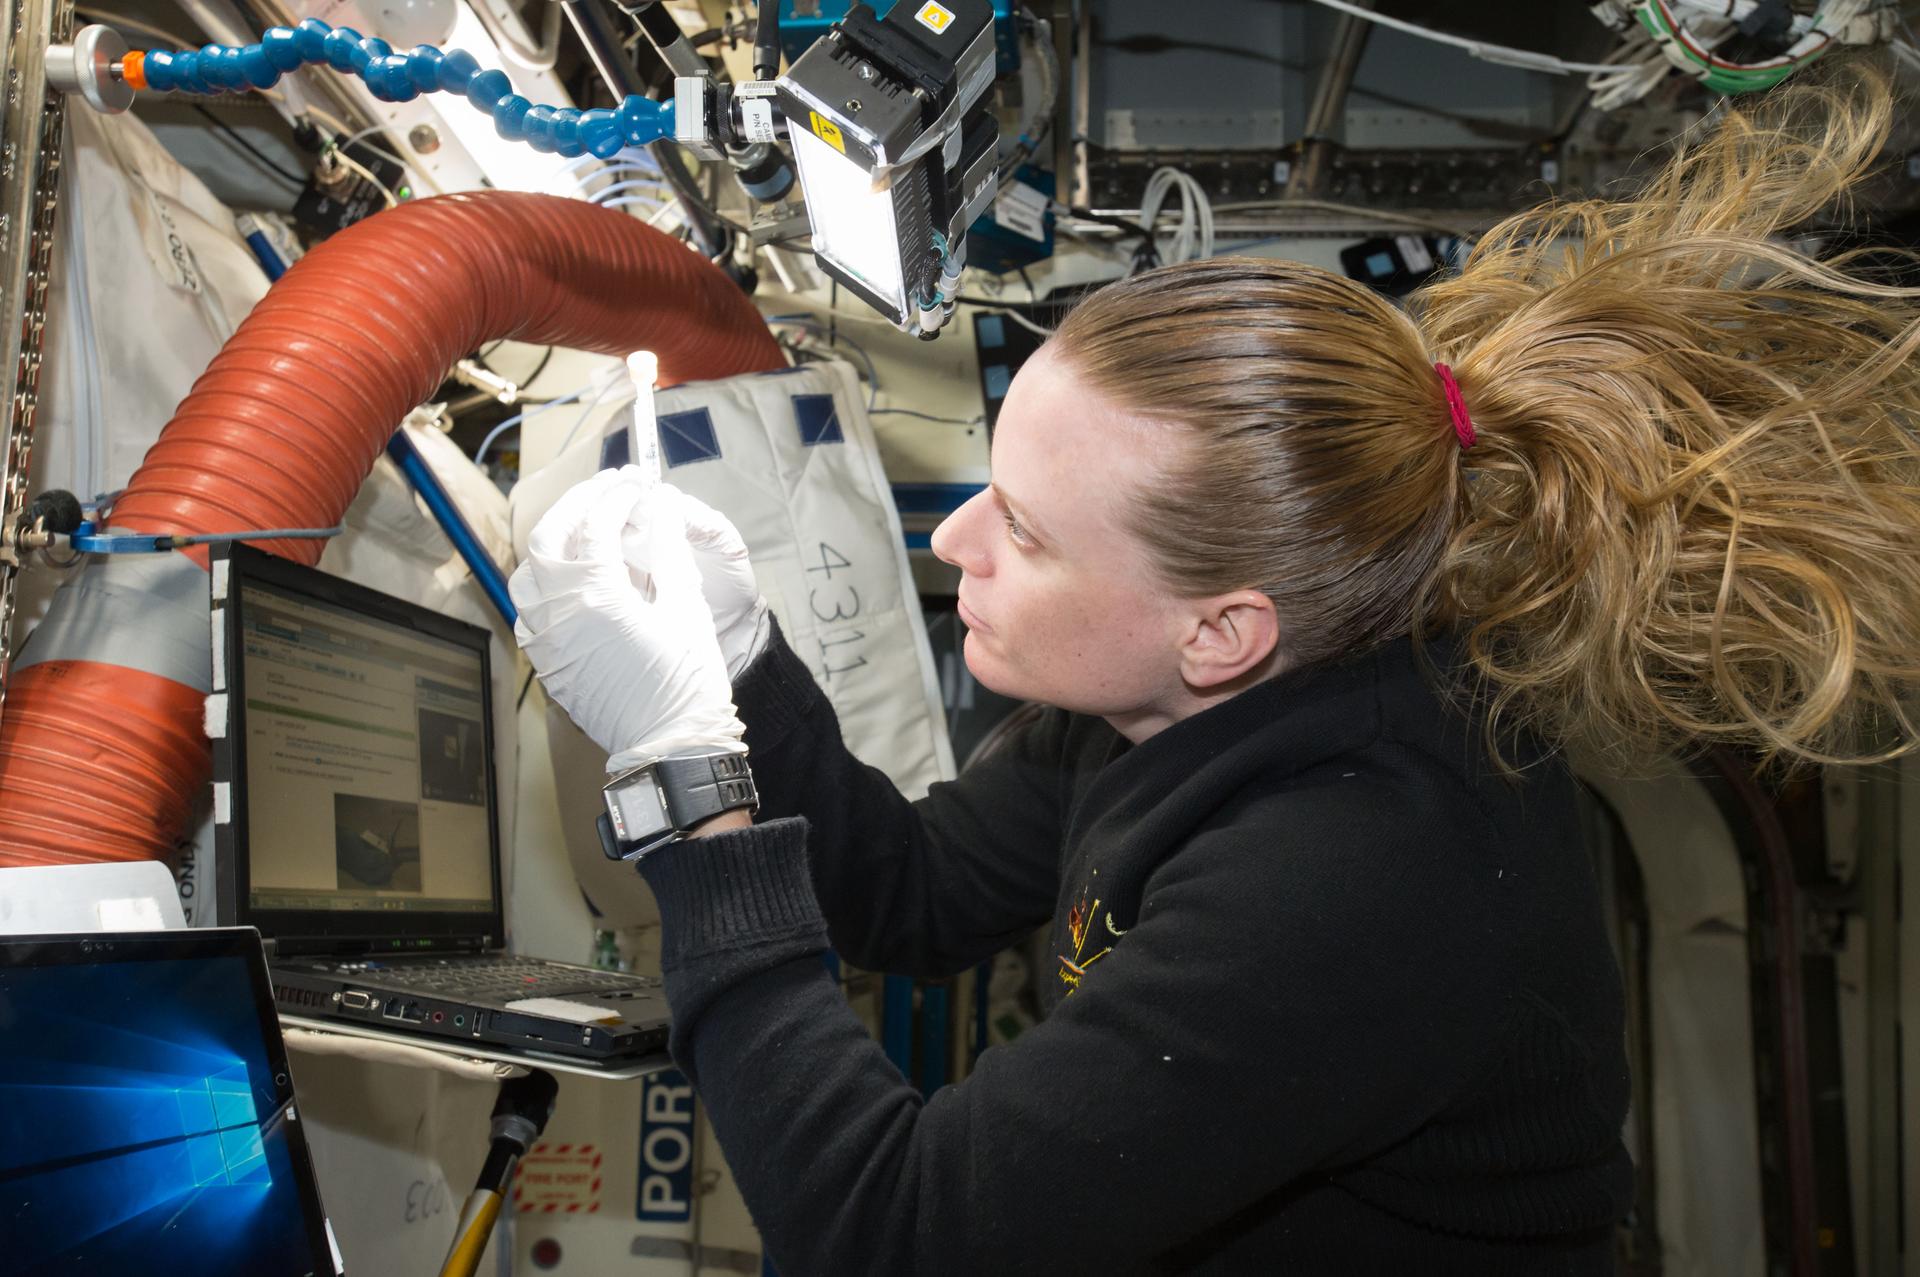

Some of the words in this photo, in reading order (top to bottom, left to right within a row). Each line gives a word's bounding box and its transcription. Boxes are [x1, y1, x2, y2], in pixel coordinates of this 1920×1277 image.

[752, 113, 761, 128] P/N
[806, 541, 869, 683] 4311
[525, 1173, 552, 1185] FIRE
[556, 1173, 591, 1185] PORT
[641, 1072, 693, 1213] POR
